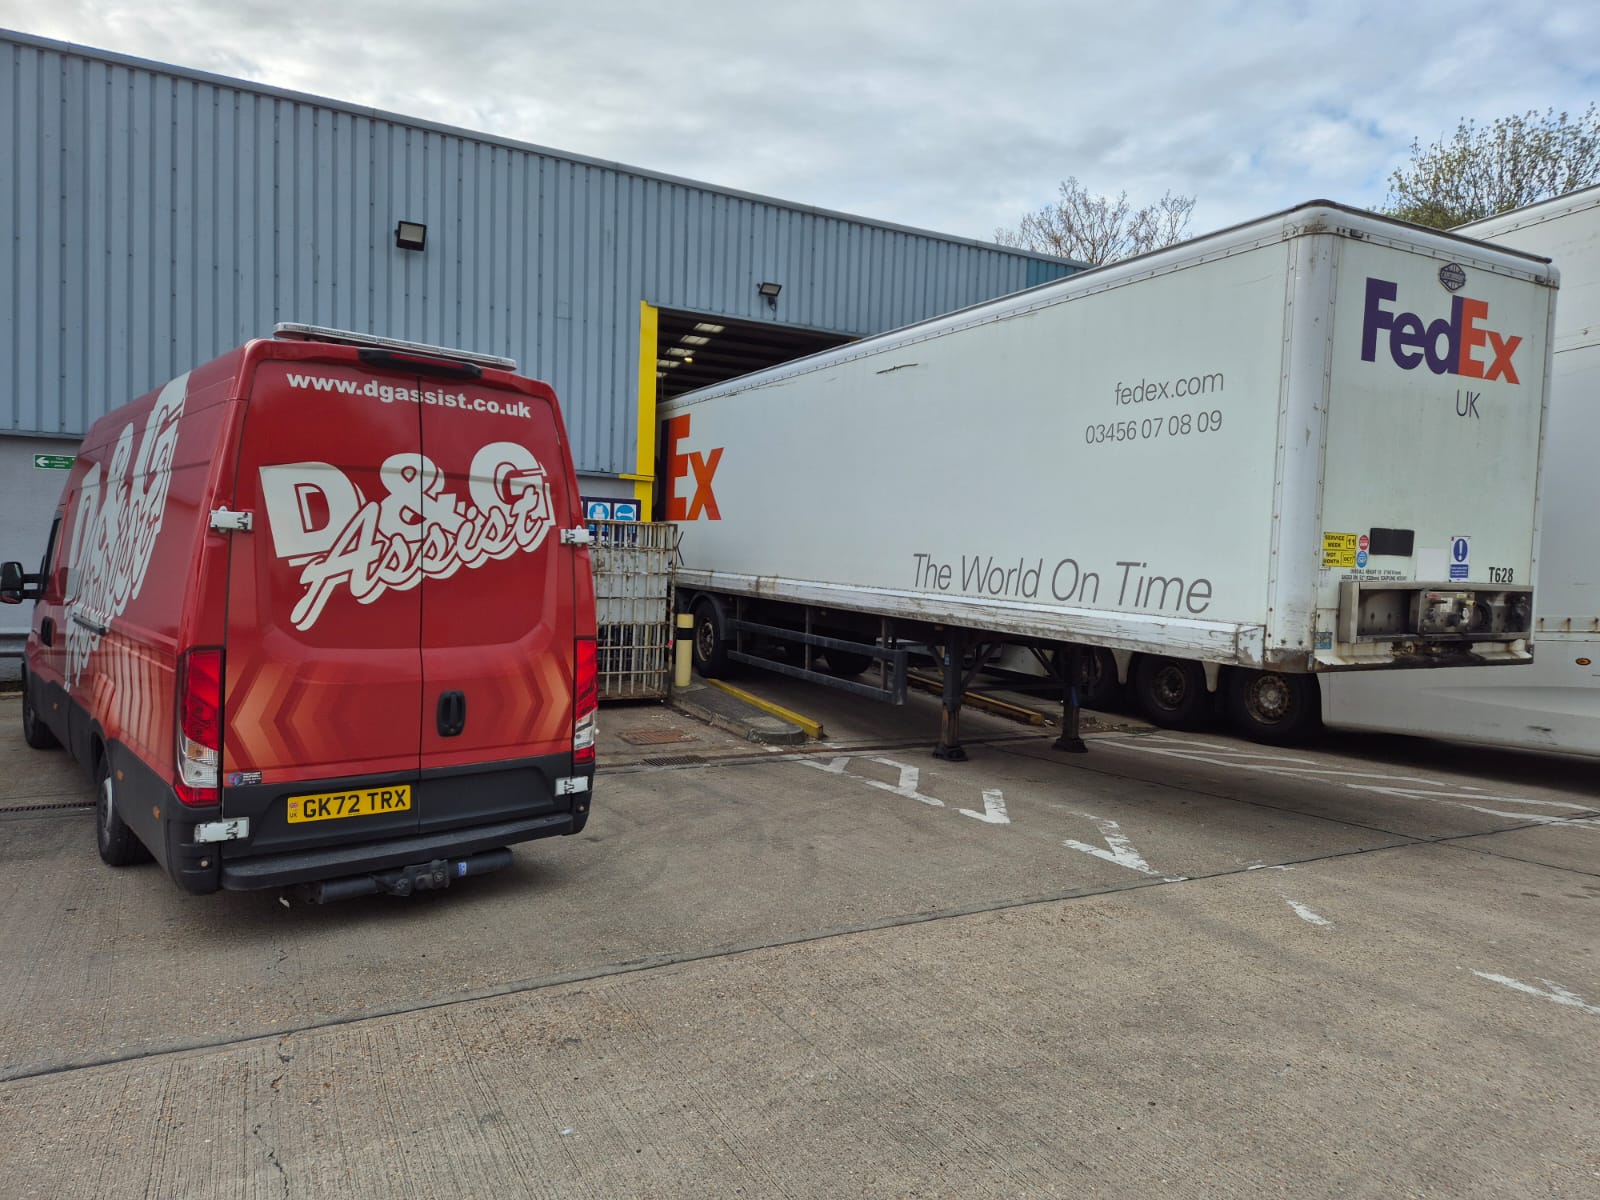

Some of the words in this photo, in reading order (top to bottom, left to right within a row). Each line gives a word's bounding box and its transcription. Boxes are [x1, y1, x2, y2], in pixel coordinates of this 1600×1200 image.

[1361, 277, 1523, 385] FedEx
[286, 373, 531, 419] www.dgassist.co.uk
[1115, 373, 1224, 406] fedex.com
[1456, 389, 1480, 419] UK
[1085, 421, 1137, 444] 03456
[1141, 418, 1164, 439] 07
[1168, 413, 1192, 436] 08
[1197, 410, 1223, 433] 09
[259, 442, 554, 566] D&G
[290, 486, 552, 631] Assist
[1488, 566, 1514, 583] T628
[913, 553, 951, 590] The
[960, 555, 1042, 599] World
[1052, 558, 1100, 603] On
[1115, 561, 1213, 614] Time
[303, 795, 360, 818] GK72
[367, 789, 406, 811] TRX
